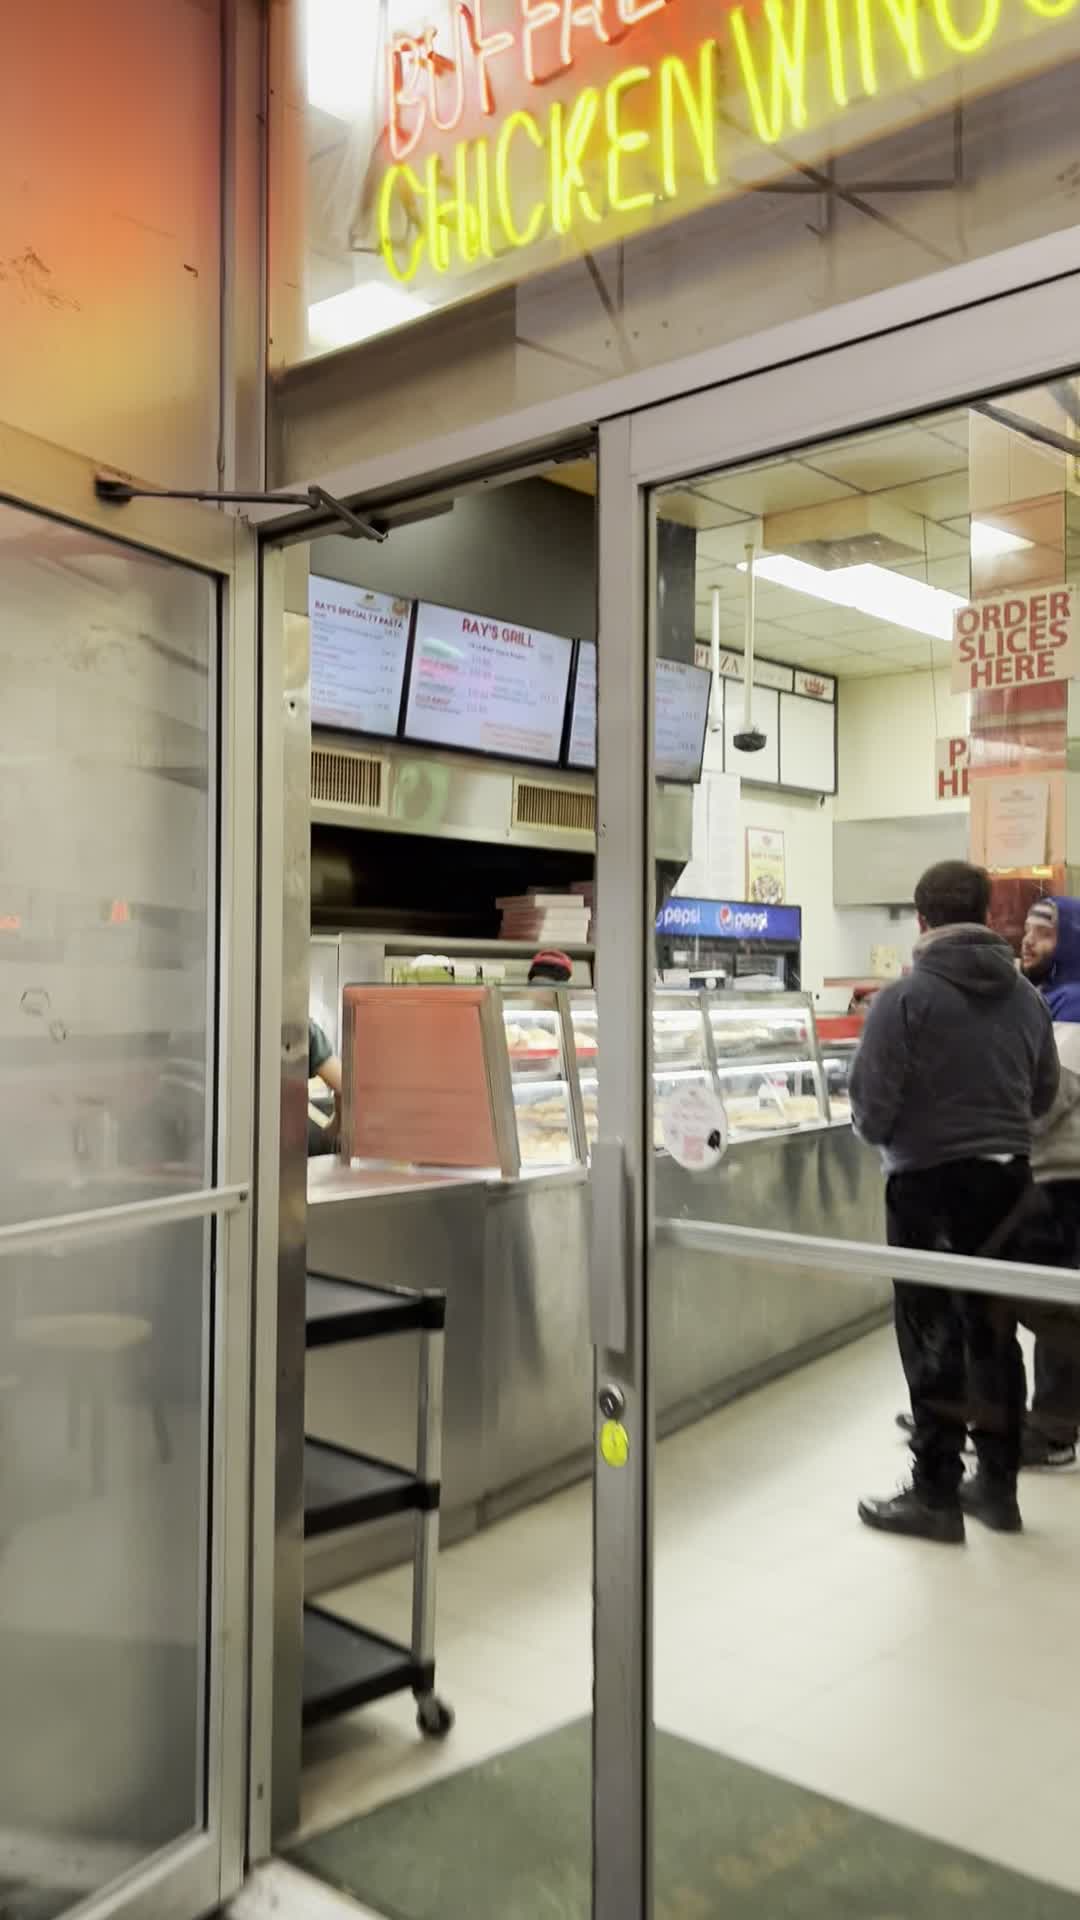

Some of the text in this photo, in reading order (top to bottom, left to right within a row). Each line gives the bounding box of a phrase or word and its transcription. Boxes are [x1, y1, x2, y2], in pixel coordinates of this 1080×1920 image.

[388, 0, 672, 158] BUFFA
[379, 0, 1079, 281] CHICKEN WIN
[462, 617, 535, 649] RAY'S GRILL
[956, 591, 1071, 636] ORDER
[695, 647, 739, 675] PIZA
[958, 620, 1068, 663] SLICES
[970, 650, 1055, 689] HERE
[664, 904, 701, 928] pepsi
[734, 909, 769, 932] pepsi
